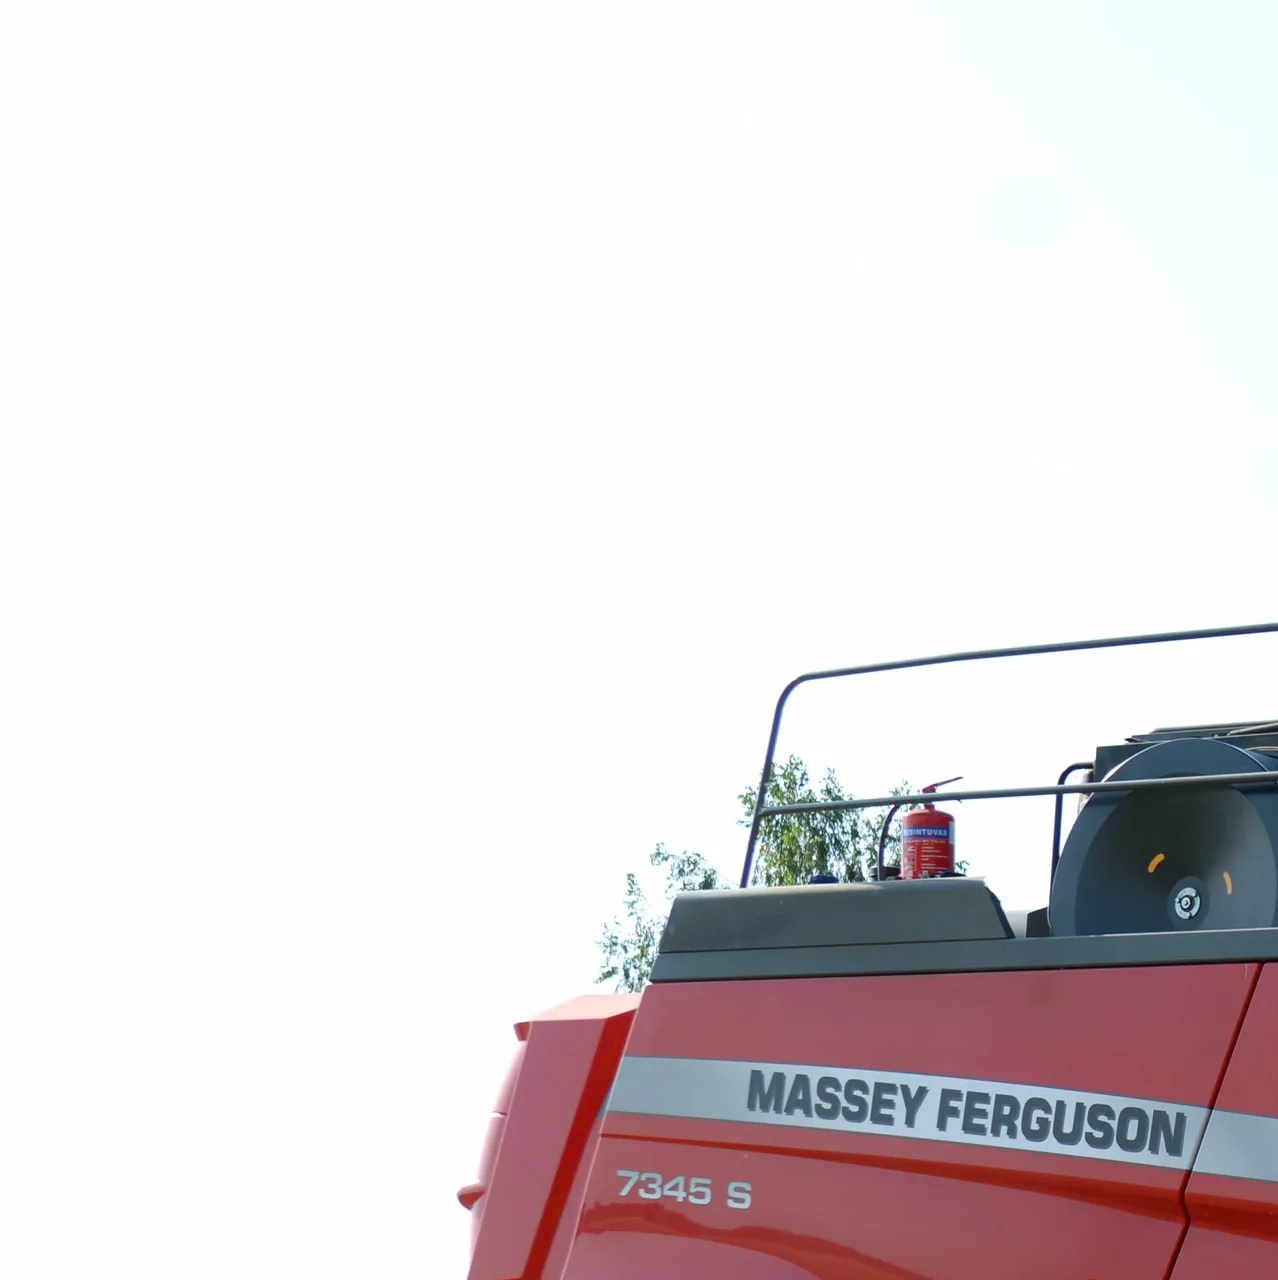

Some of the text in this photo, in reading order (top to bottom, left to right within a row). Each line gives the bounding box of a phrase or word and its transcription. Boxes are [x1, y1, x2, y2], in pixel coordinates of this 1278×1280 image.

[747, 1069, 1188, 1158] MASSEY FERGUSON
[616, 1169, 753, 1210] 7345 S
